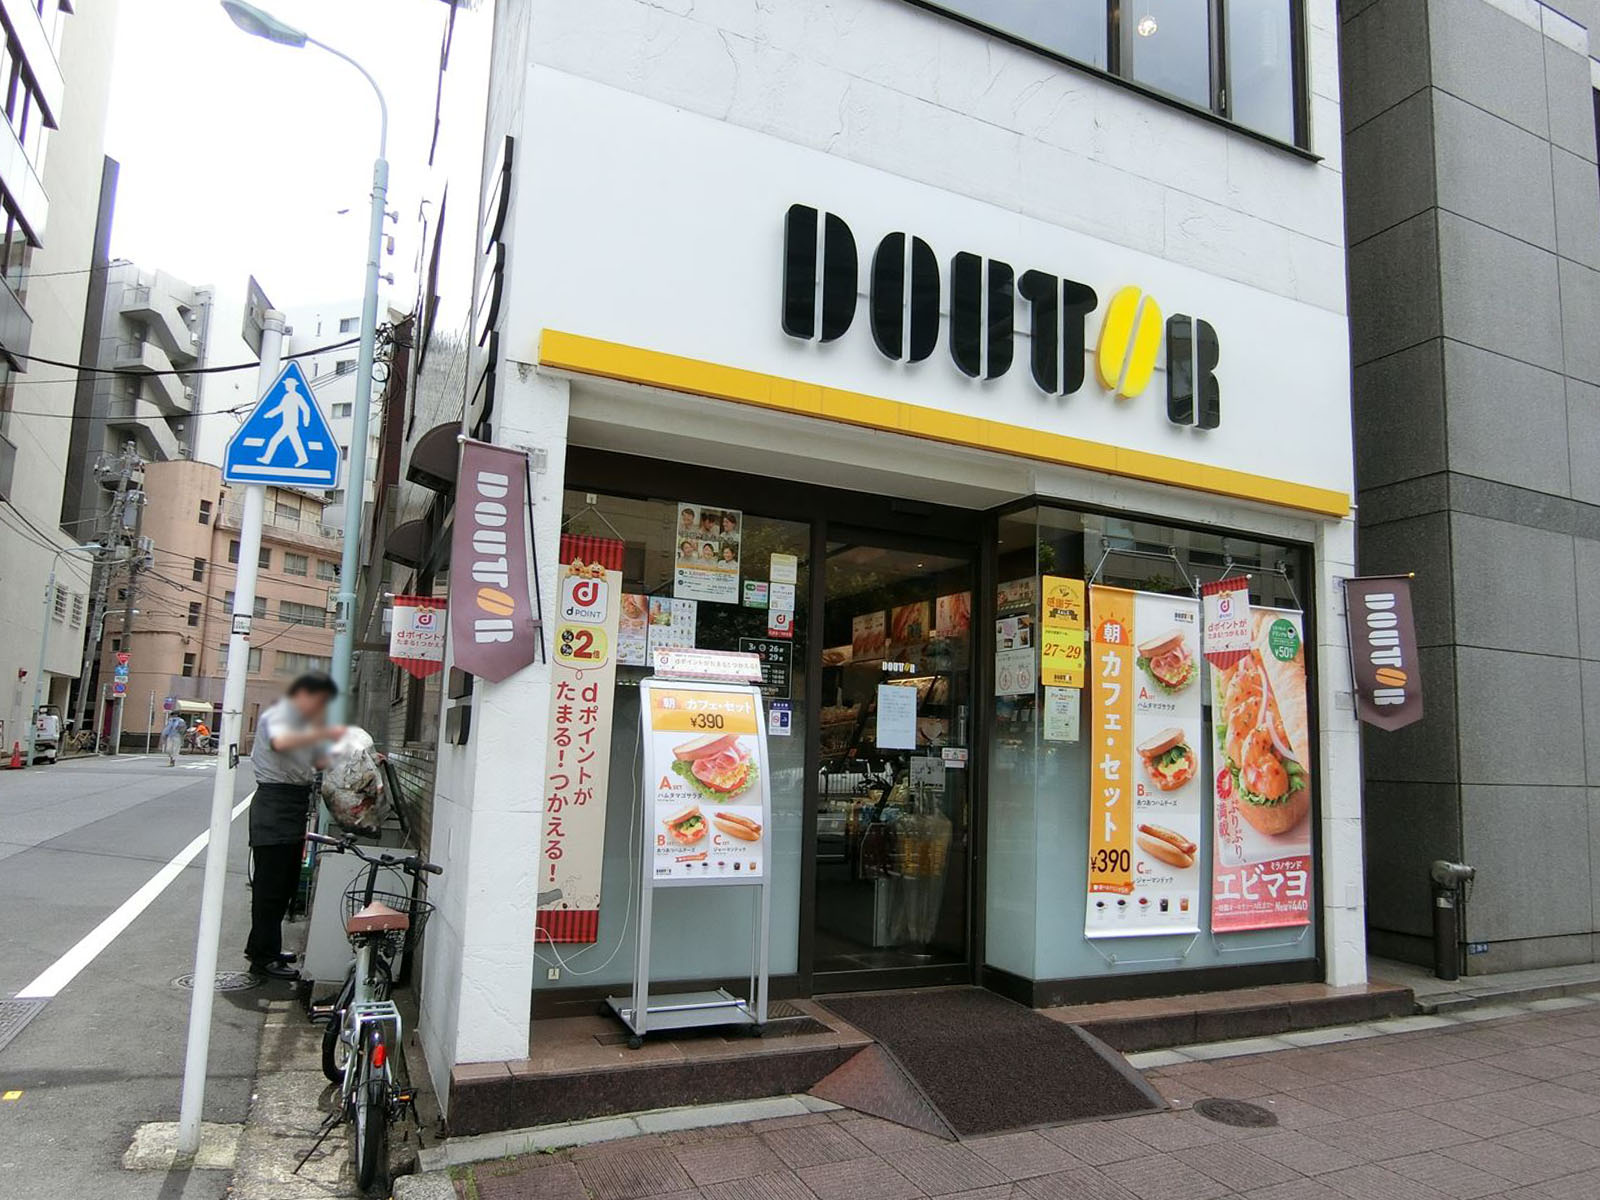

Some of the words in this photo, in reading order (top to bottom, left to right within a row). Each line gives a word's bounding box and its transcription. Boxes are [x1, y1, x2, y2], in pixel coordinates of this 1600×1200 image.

[781, 203, 1221, 431] DOUTOR
[472, 471, 515, 643] DOUTOR
[575, 608, 602, 619] POINT
[1104, 622, 1121, 643] 朝
[1364, 593, 1407, 705] DOUTOR
[687, 699, 751, 714] カフェ・セット
[690, 713, 724, 729] ¥390
[573, 682, 599, 807] dポイントが
[1100, 651, 1122, 842] カフェ・セット
[660, 776, 671, 790] A
[1137, 784, 1145, 796] B
[1091, 849, 1130, 873] ¥390
[1214, 863, 1308, 901] エビマヨ
